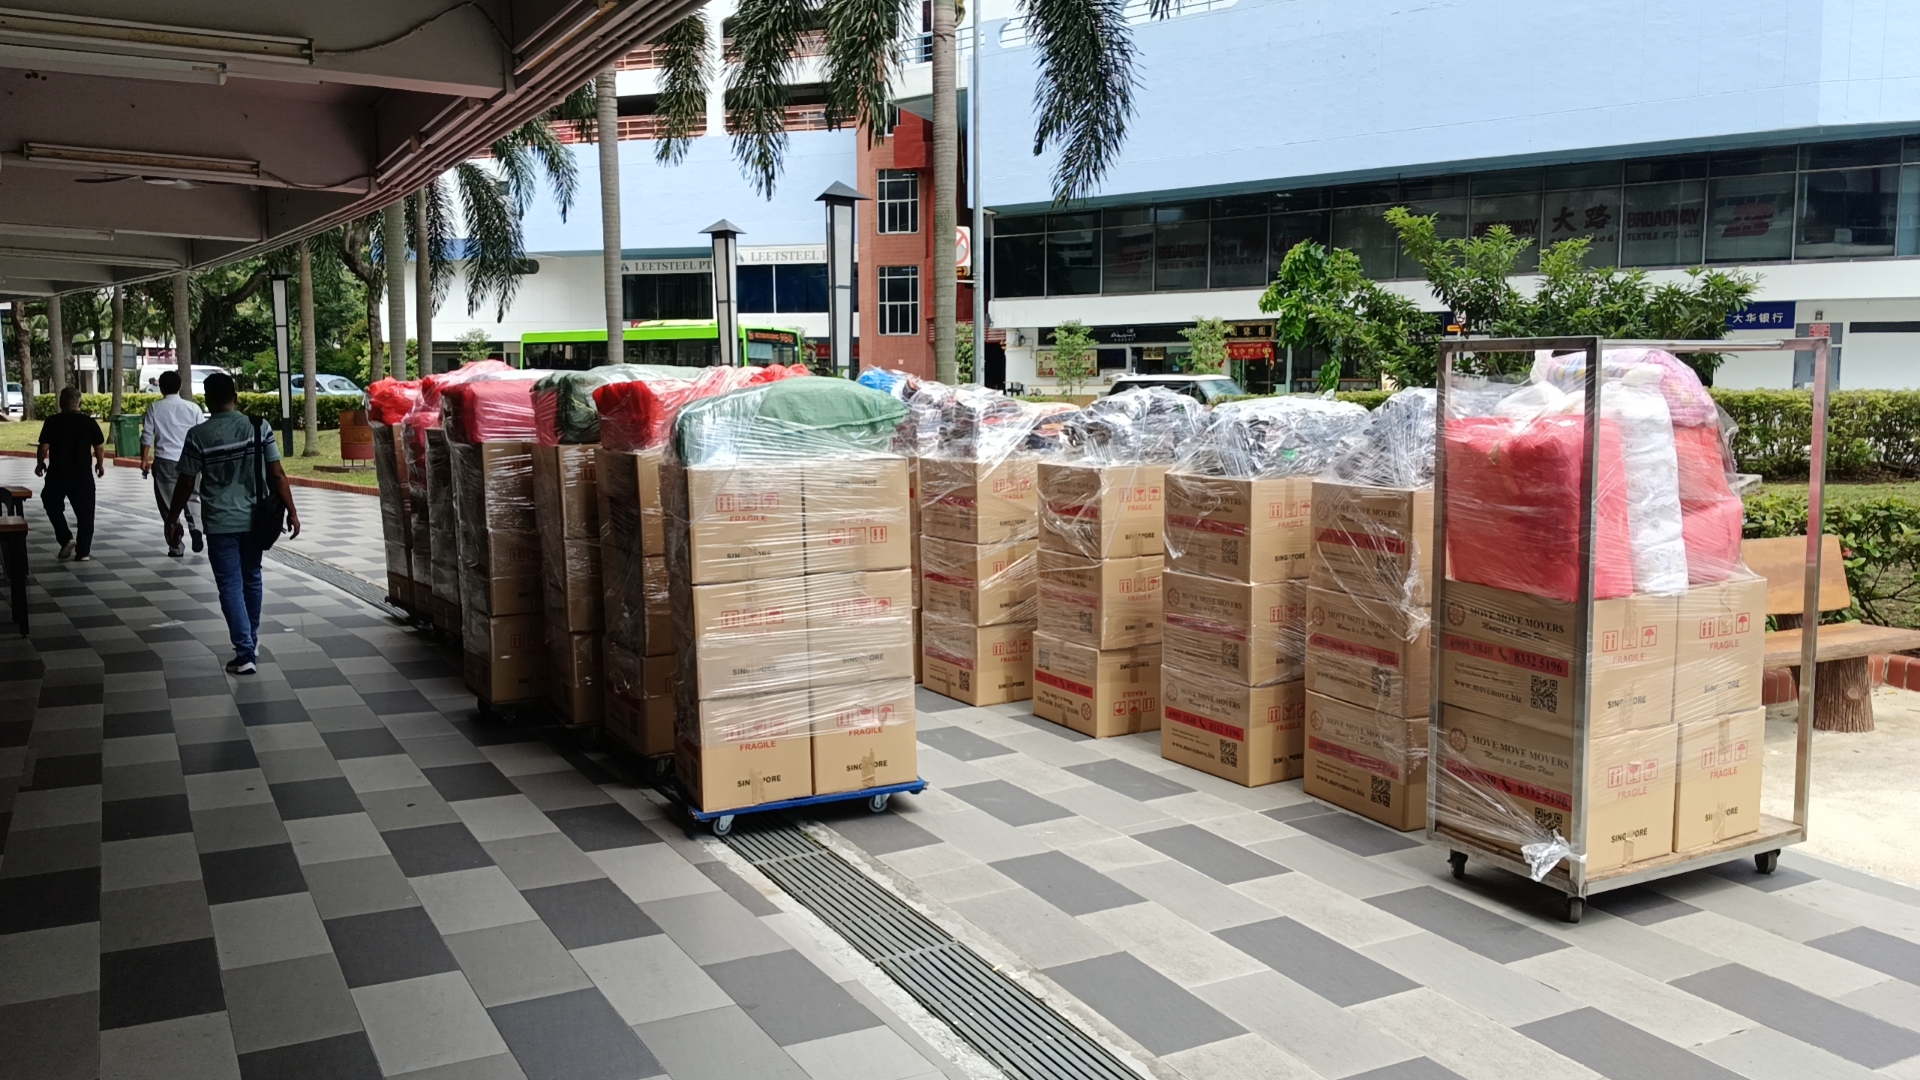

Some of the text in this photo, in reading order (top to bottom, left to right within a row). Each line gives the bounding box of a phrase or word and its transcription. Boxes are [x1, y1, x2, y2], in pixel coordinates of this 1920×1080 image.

[1551, 203, 1611, 233] 大路
[1627, 208, 1700, 229] BROADWAY
[1627, 231, 1659, 241] TEXTILE
[750, 250, 819, 262] LEETSTEEL
[635, 260, 712, 272] LEETSTEEL PT
[729, 514, 767, 522] FRAGILE
[1372, 508, 1402, 518] MOVERS
[1278, 520, 1304, 528] FRAGILE
[1181, 592, 1243, 610] MOVE MOVE MOVERS
[1327, 610, 1345, 621] MOVE
[1347, 614, 1366, 625] MOVE
[1469, 607, 1565, 634] MOVE MOVE MOVERS
[1709, 638, 1740, 651] FRAGILE
[1000, 655, 1023, 663] FRAGILE
[1449, 638, 1563, 674] 6909 3840 8332 5196
[1612, 652, 1646, 665] FRAGILE
[1122, 690, 1147, 698] FRAGILE
[1453, 680, 1523, 704] www.movemove.biz
[1197, 692, 1214, 704] MOVE
[1215, 697, 1241, 710] MOVERS
[848, 726, 884, 737] FRAGILE
[1276, 721, 1302, 732] FRAGILE
[1325, 716, 1344, 728] MOVE
[1345, 722, 1366, 734] MOVE
[739, 740, 777, 752] FRAGILE
[1472, 735, 1570, 770] MOVE MOVE MOVERS
[1483, 750, 1506, 764] Moving
[1518, 760, 1536, 772] Better
[1537, 765, 1555, 777] Place
[1709, 766, 1738, 780] FRAGILE
[1315, 774, 1366, 798] www.movemove.biz
[1617, 786, 1648, 800] FRAGILE
[1517, 784, 1540, 800] 8332
[1543, 792, 1569, 808] 5196
[1610, 827, 1648, 843] SINGORE
